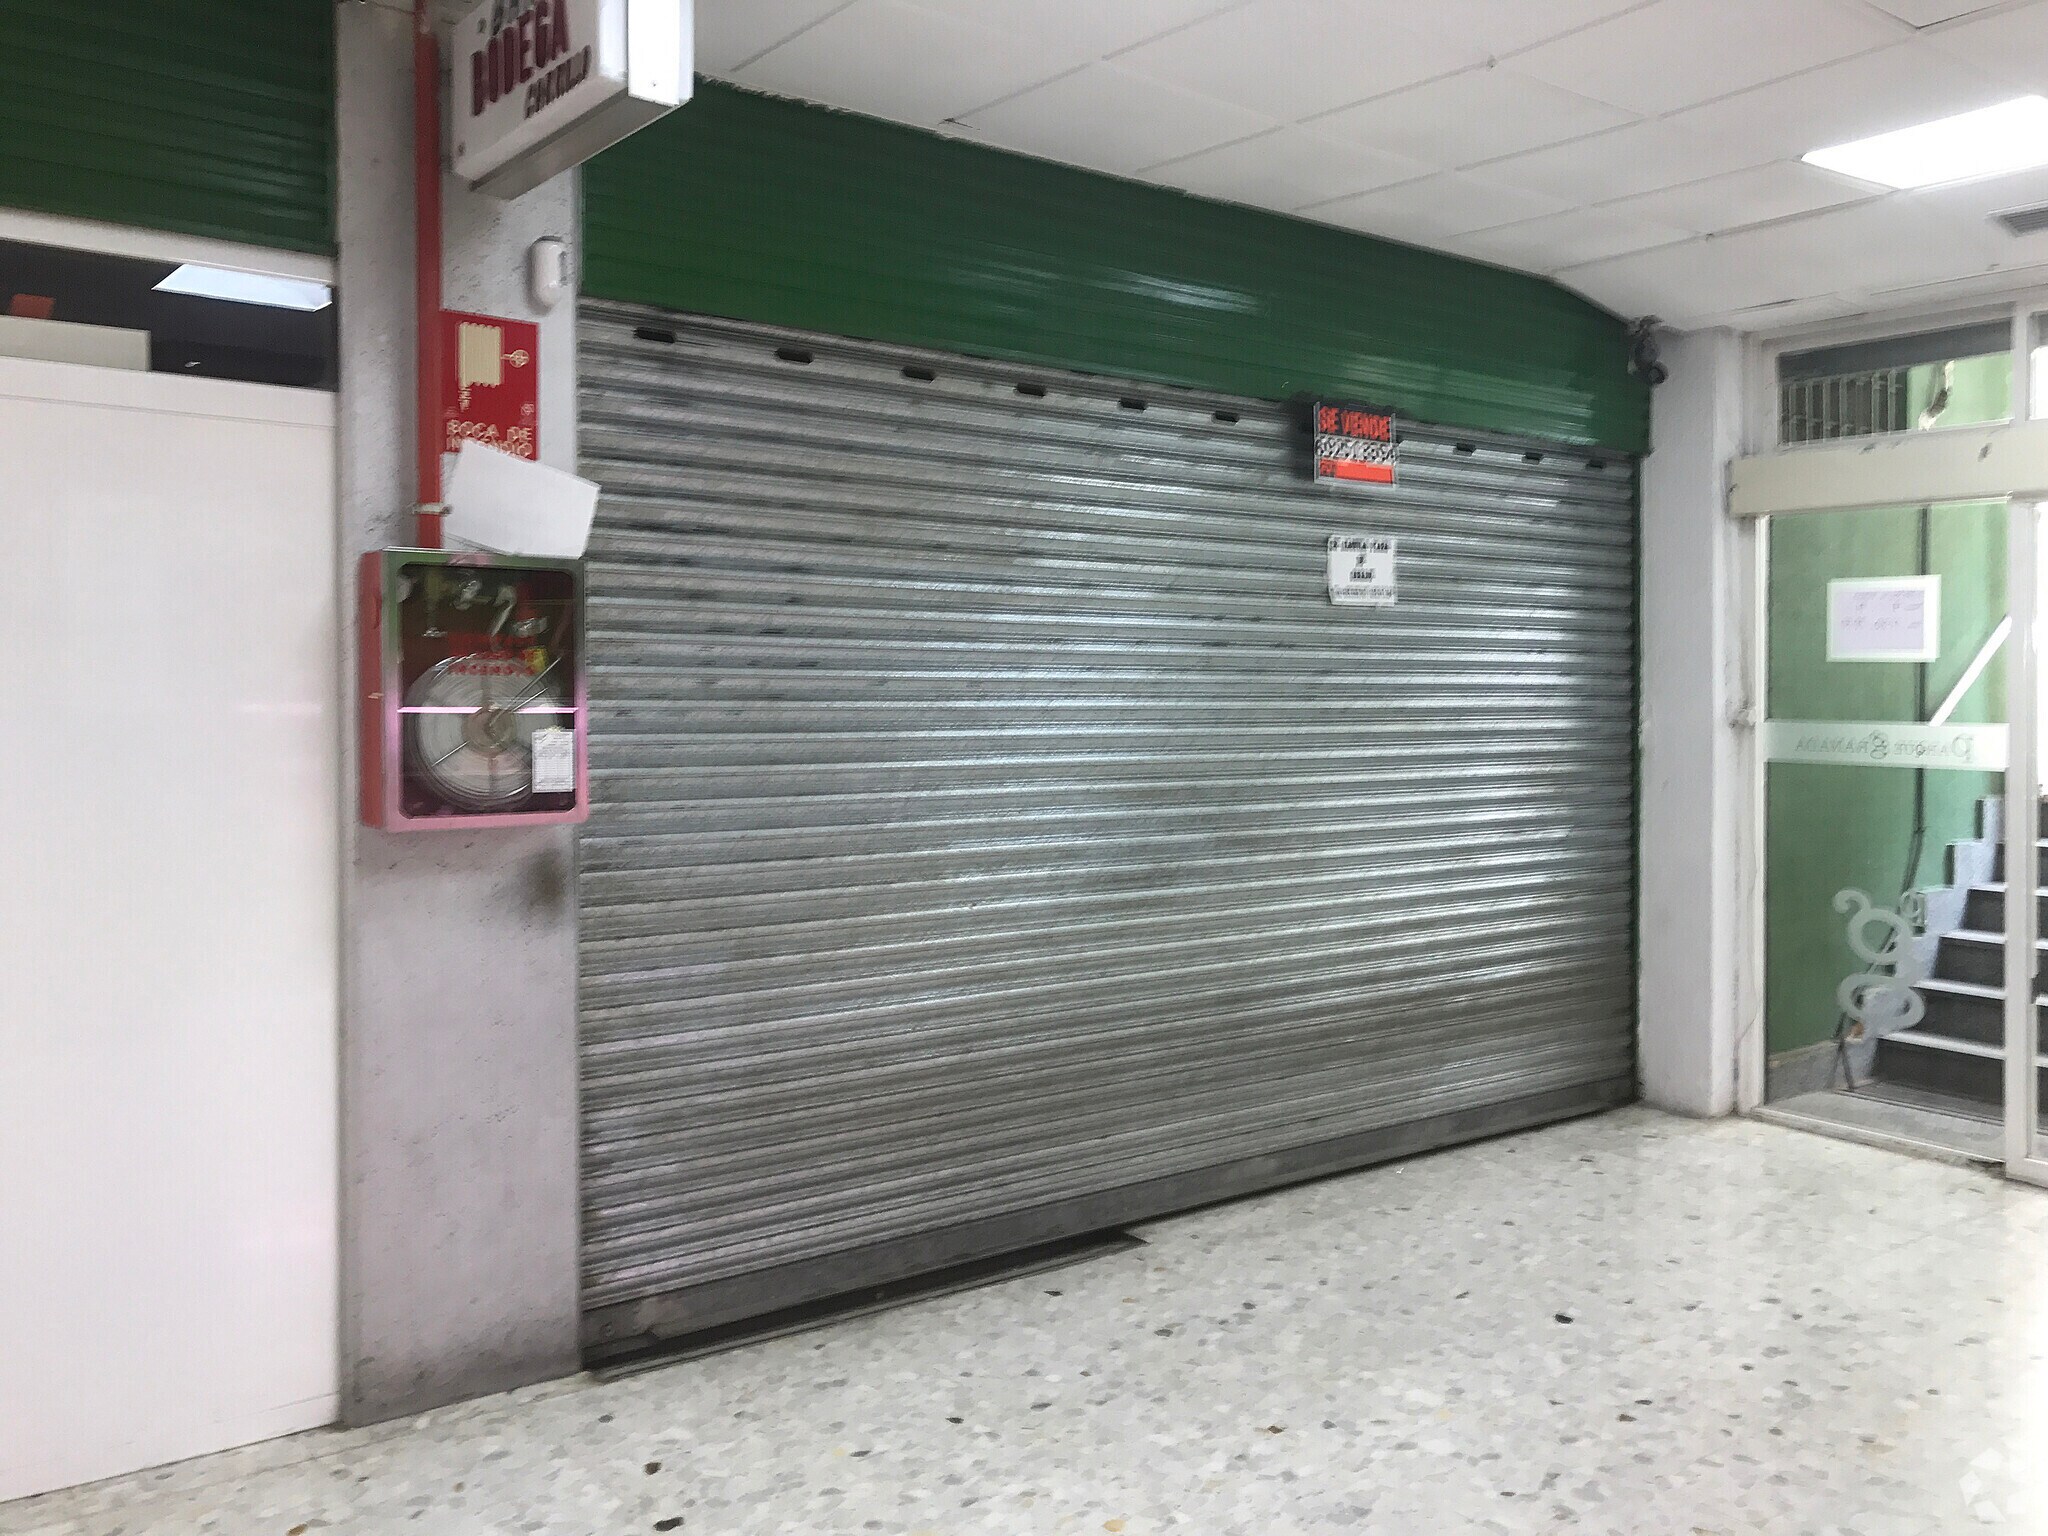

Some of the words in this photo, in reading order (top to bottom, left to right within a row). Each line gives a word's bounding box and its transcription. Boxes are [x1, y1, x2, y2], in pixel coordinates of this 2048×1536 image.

[470, 0, 569, 117] BODEGA
[446, 419, 500, 442] BOCA
[506, 426, 532, 442] DE
[1318, 406, 1338, 433] SE
[1341, 410, 1391, 442] VENDE
